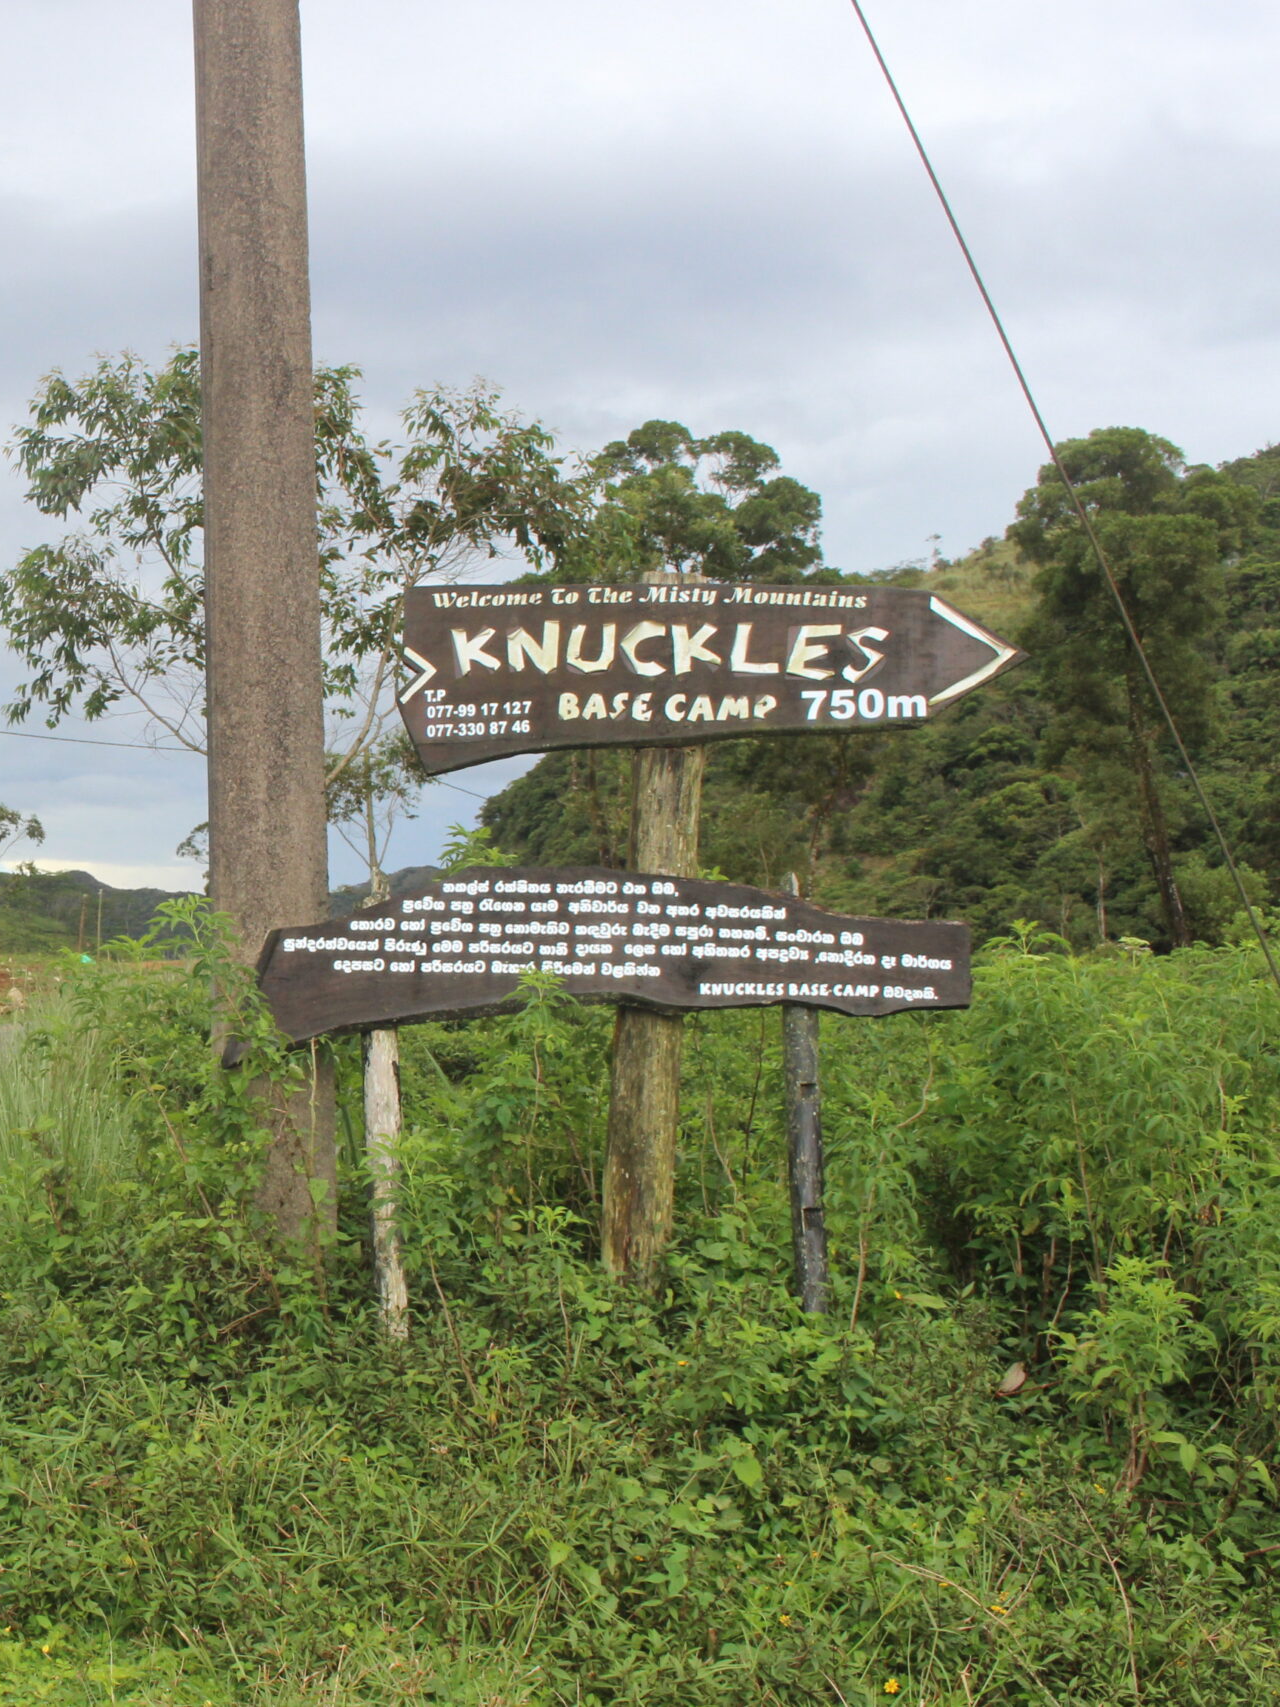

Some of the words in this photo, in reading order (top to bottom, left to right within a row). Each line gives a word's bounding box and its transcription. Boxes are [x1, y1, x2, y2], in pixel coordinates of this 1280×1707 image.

[431, 591, 543, 609] Welcome
[550, 588, 580, 605] To
[587, 587, 633, 604] The
[638, 585, 718, 607] Misty
[723, 586, 868, 609] Mountains
[450, 620, 890, 684] KNUCKLES
[423, 689, 447, 703] T.P
[557, 692, 653, 722] BASE
[664, 693, 777, 722] CAMP
[800, 688, 928, 722] 750m
[426, 703, 477, 720] 077-99
[480, 702, 499, 717] 17
[502, 700, 533, 716] 127
[426, 721, 486, 739] 077-330
[488, 720, 508, 735] 87
[511, 719, 531, 734] 46
[699, 982, 785, 997] KNUCKLES
[788, 982, 829, 997] BASE
[831, 983, 880, 998] CAMP
